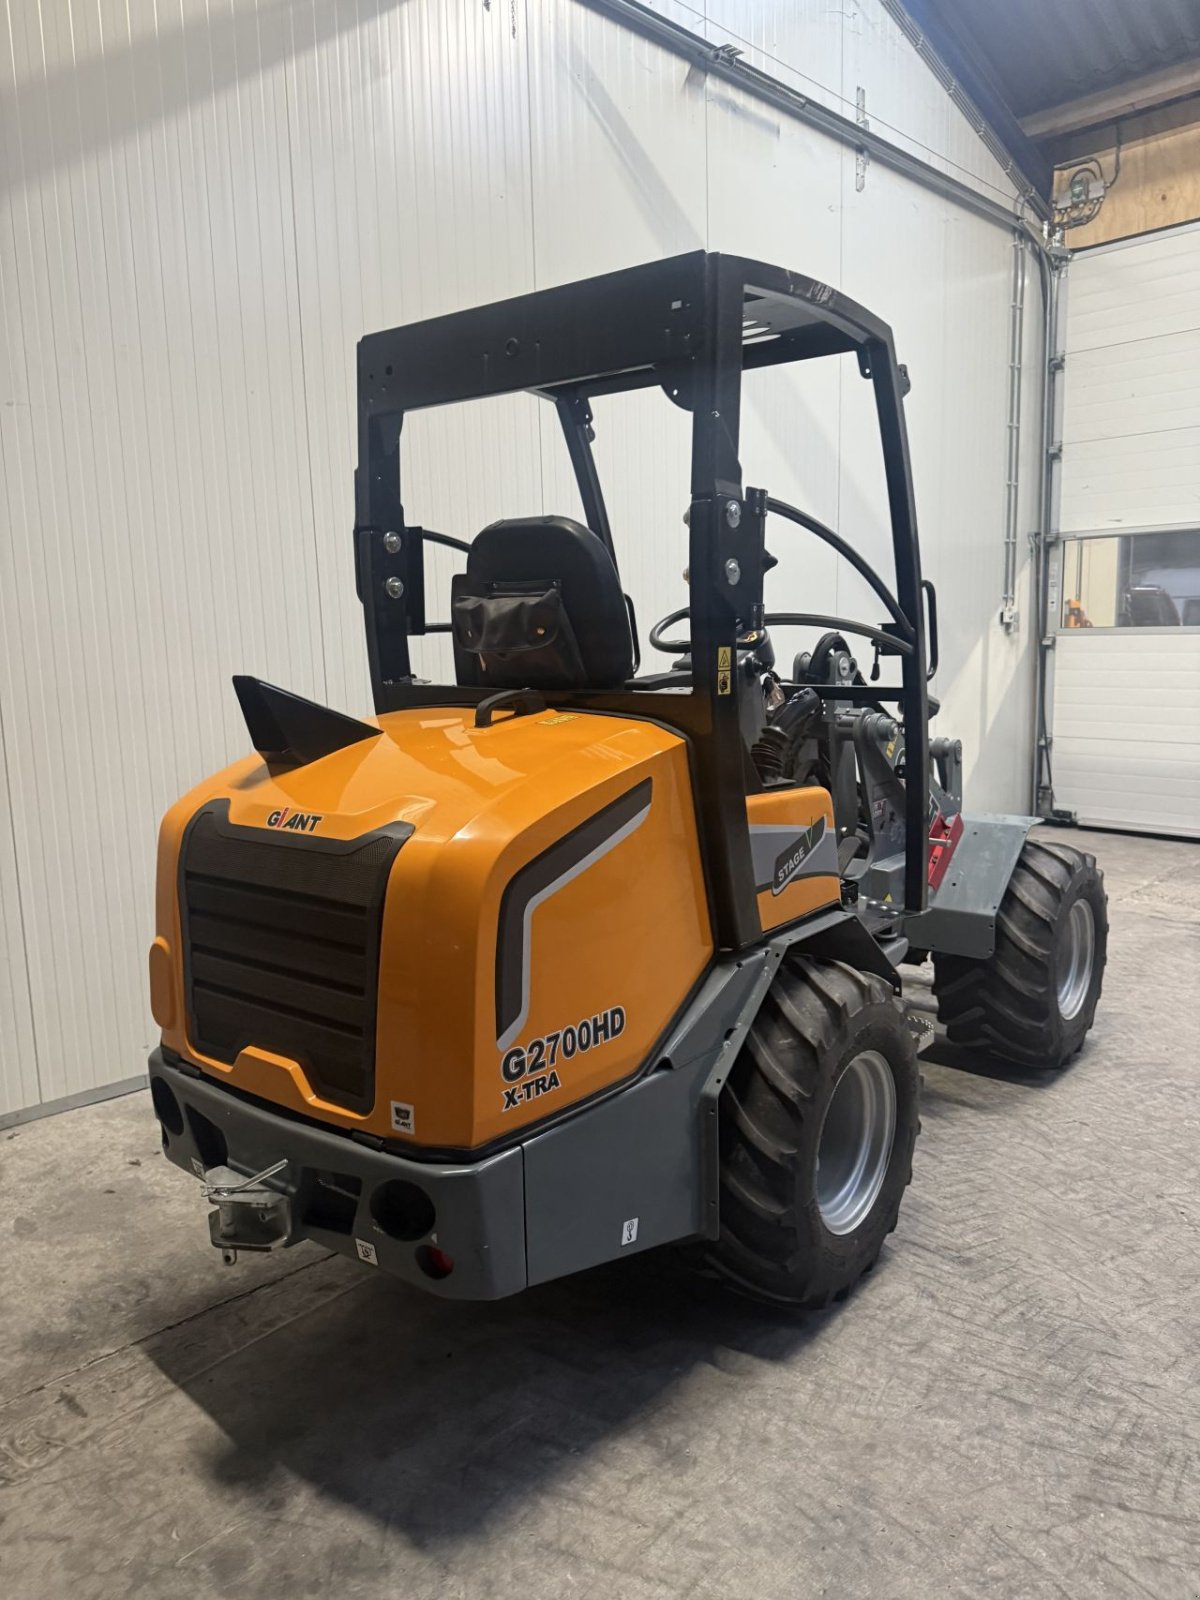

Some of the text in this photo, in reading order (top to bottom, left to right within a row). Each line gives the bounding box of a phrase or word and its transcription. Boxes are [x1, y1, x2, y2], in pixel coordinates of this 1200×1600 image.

[267, 807, 323, 832] GIANT
[778, 846, 806, 882] STAGE
[501, 1005, 626, 1084] G2700HD
[501, 1069, 562, 1112] X-TRA
